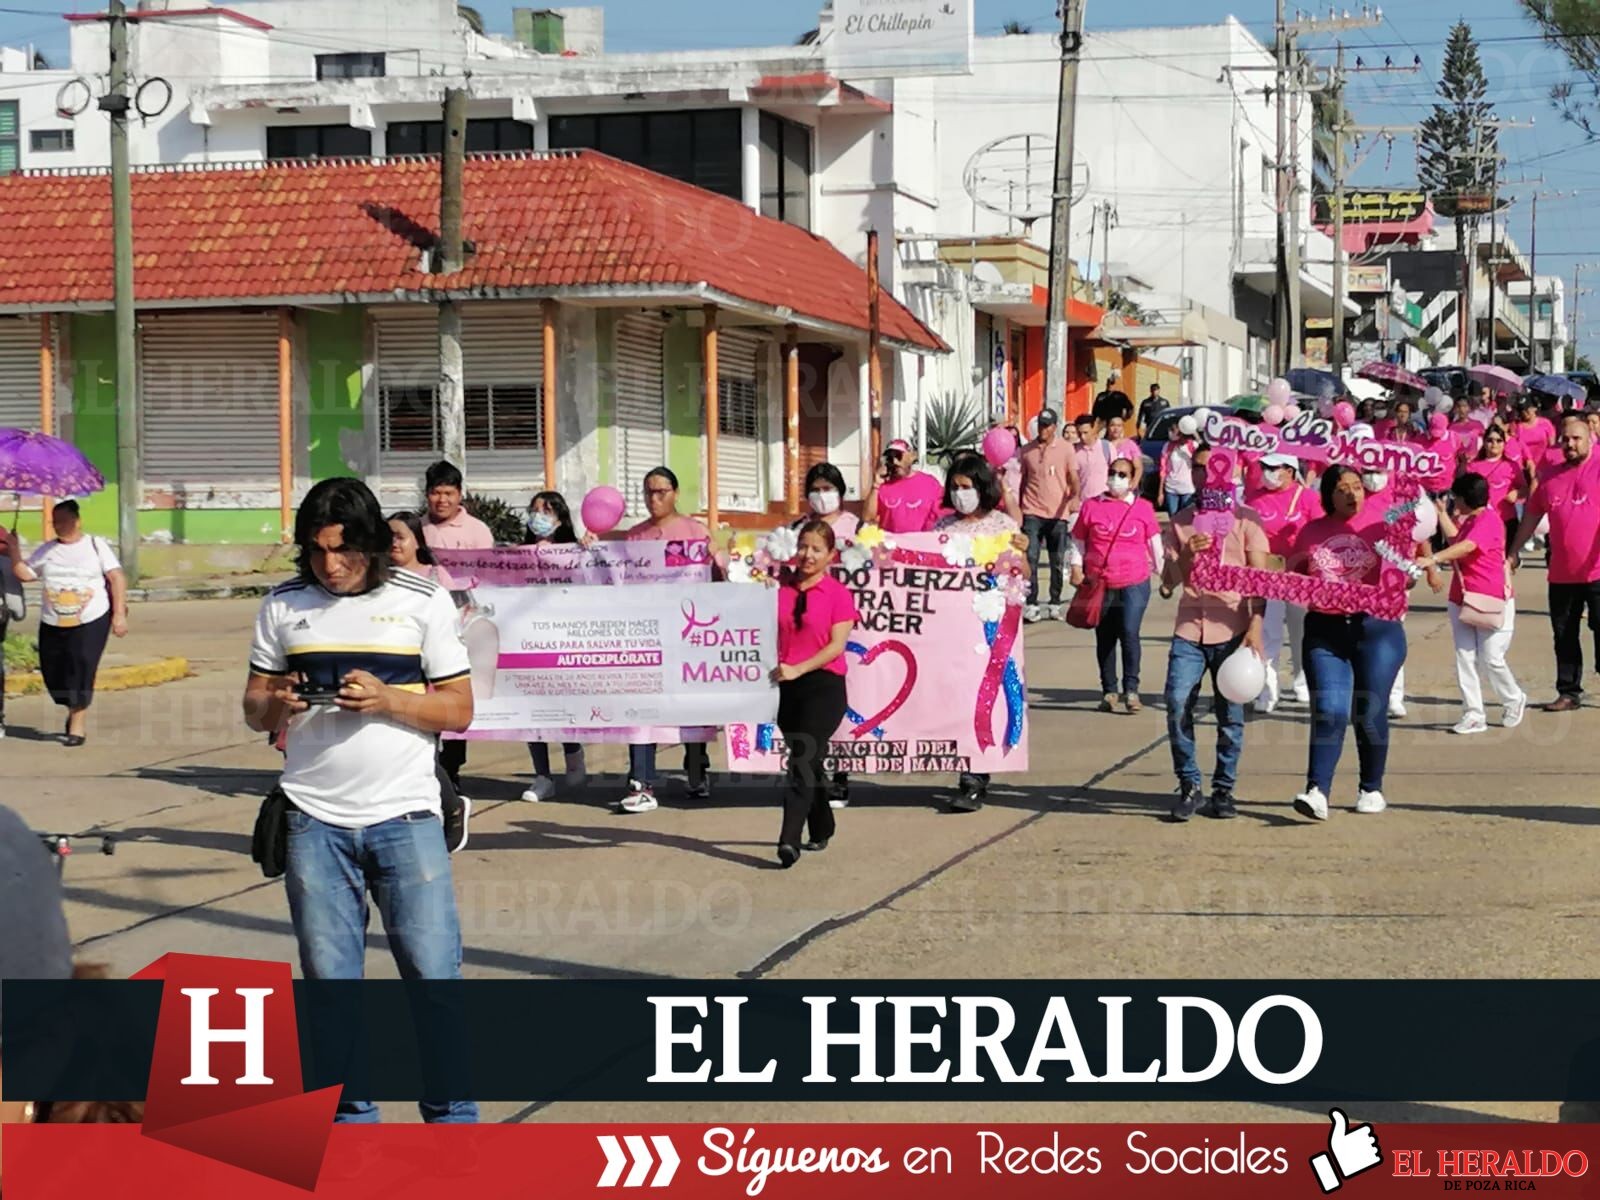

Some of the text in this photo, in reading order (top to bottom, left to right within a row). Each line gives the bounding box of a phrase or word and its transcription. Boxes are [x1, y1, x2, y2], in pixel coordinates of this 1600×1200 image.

[845, 15, 864, 34] El
[1326, 430, 1445, 476] Mama
[634, 556, 652, 568] de
[879, 568, 991, 592] FUERZAS
[851, 588, 936, 614] TRA EL
[853, 611, 923, 635] NCER
[560, 641, 584, 649] PARA
[587, 640, 623, 649] SALVAR
[625, 639, 638, 648] TU
[640, 639, 662, 648] VIDA
[689, 628, 761, 647] #DATE
[720, 649, 761, 663] una
[917, 740, 958, 756] DEL
[876, 757, 904, 772] DE
[911, 756, 970, 773] MAMA
